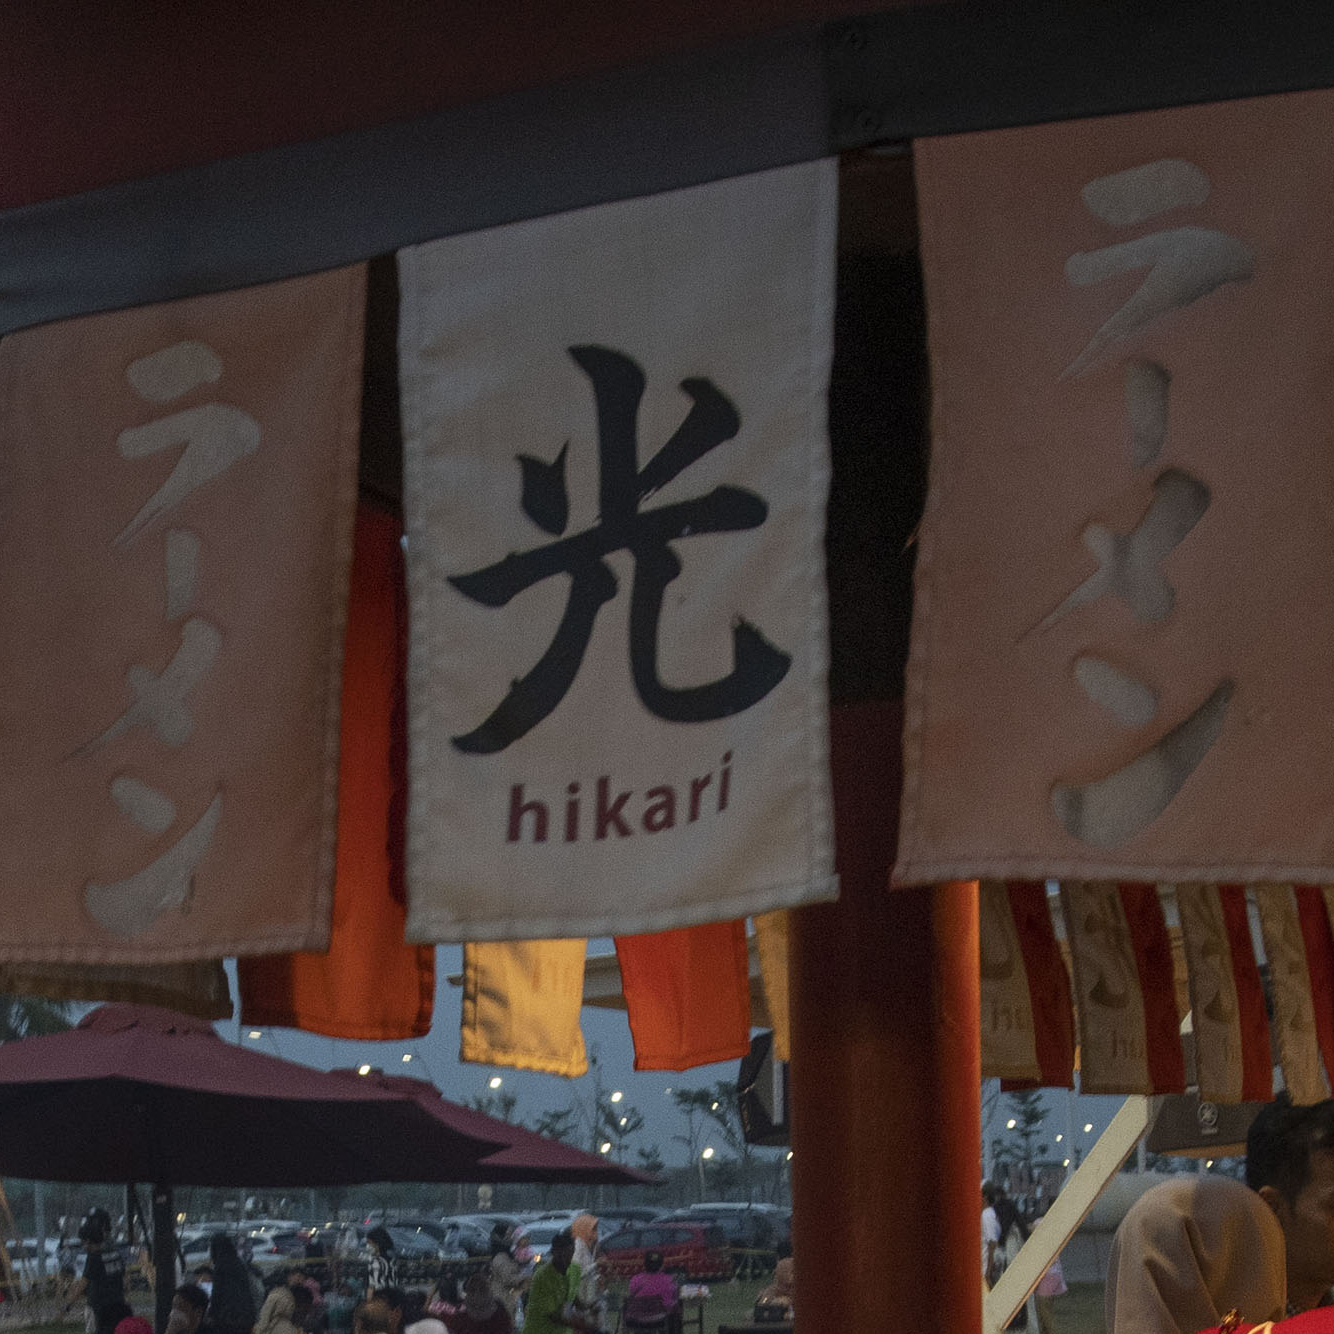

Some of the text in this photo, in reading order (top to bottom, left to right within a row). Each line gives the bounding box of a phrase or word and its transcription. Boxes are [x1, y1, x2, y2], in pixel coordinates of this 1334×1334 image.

[60, 340, 264, 936] ラーメン
[447, 344, 791, 754] 光
[1014, 158, 1255, 850] ラーメン
[505, 751, 734, 844] hikari
